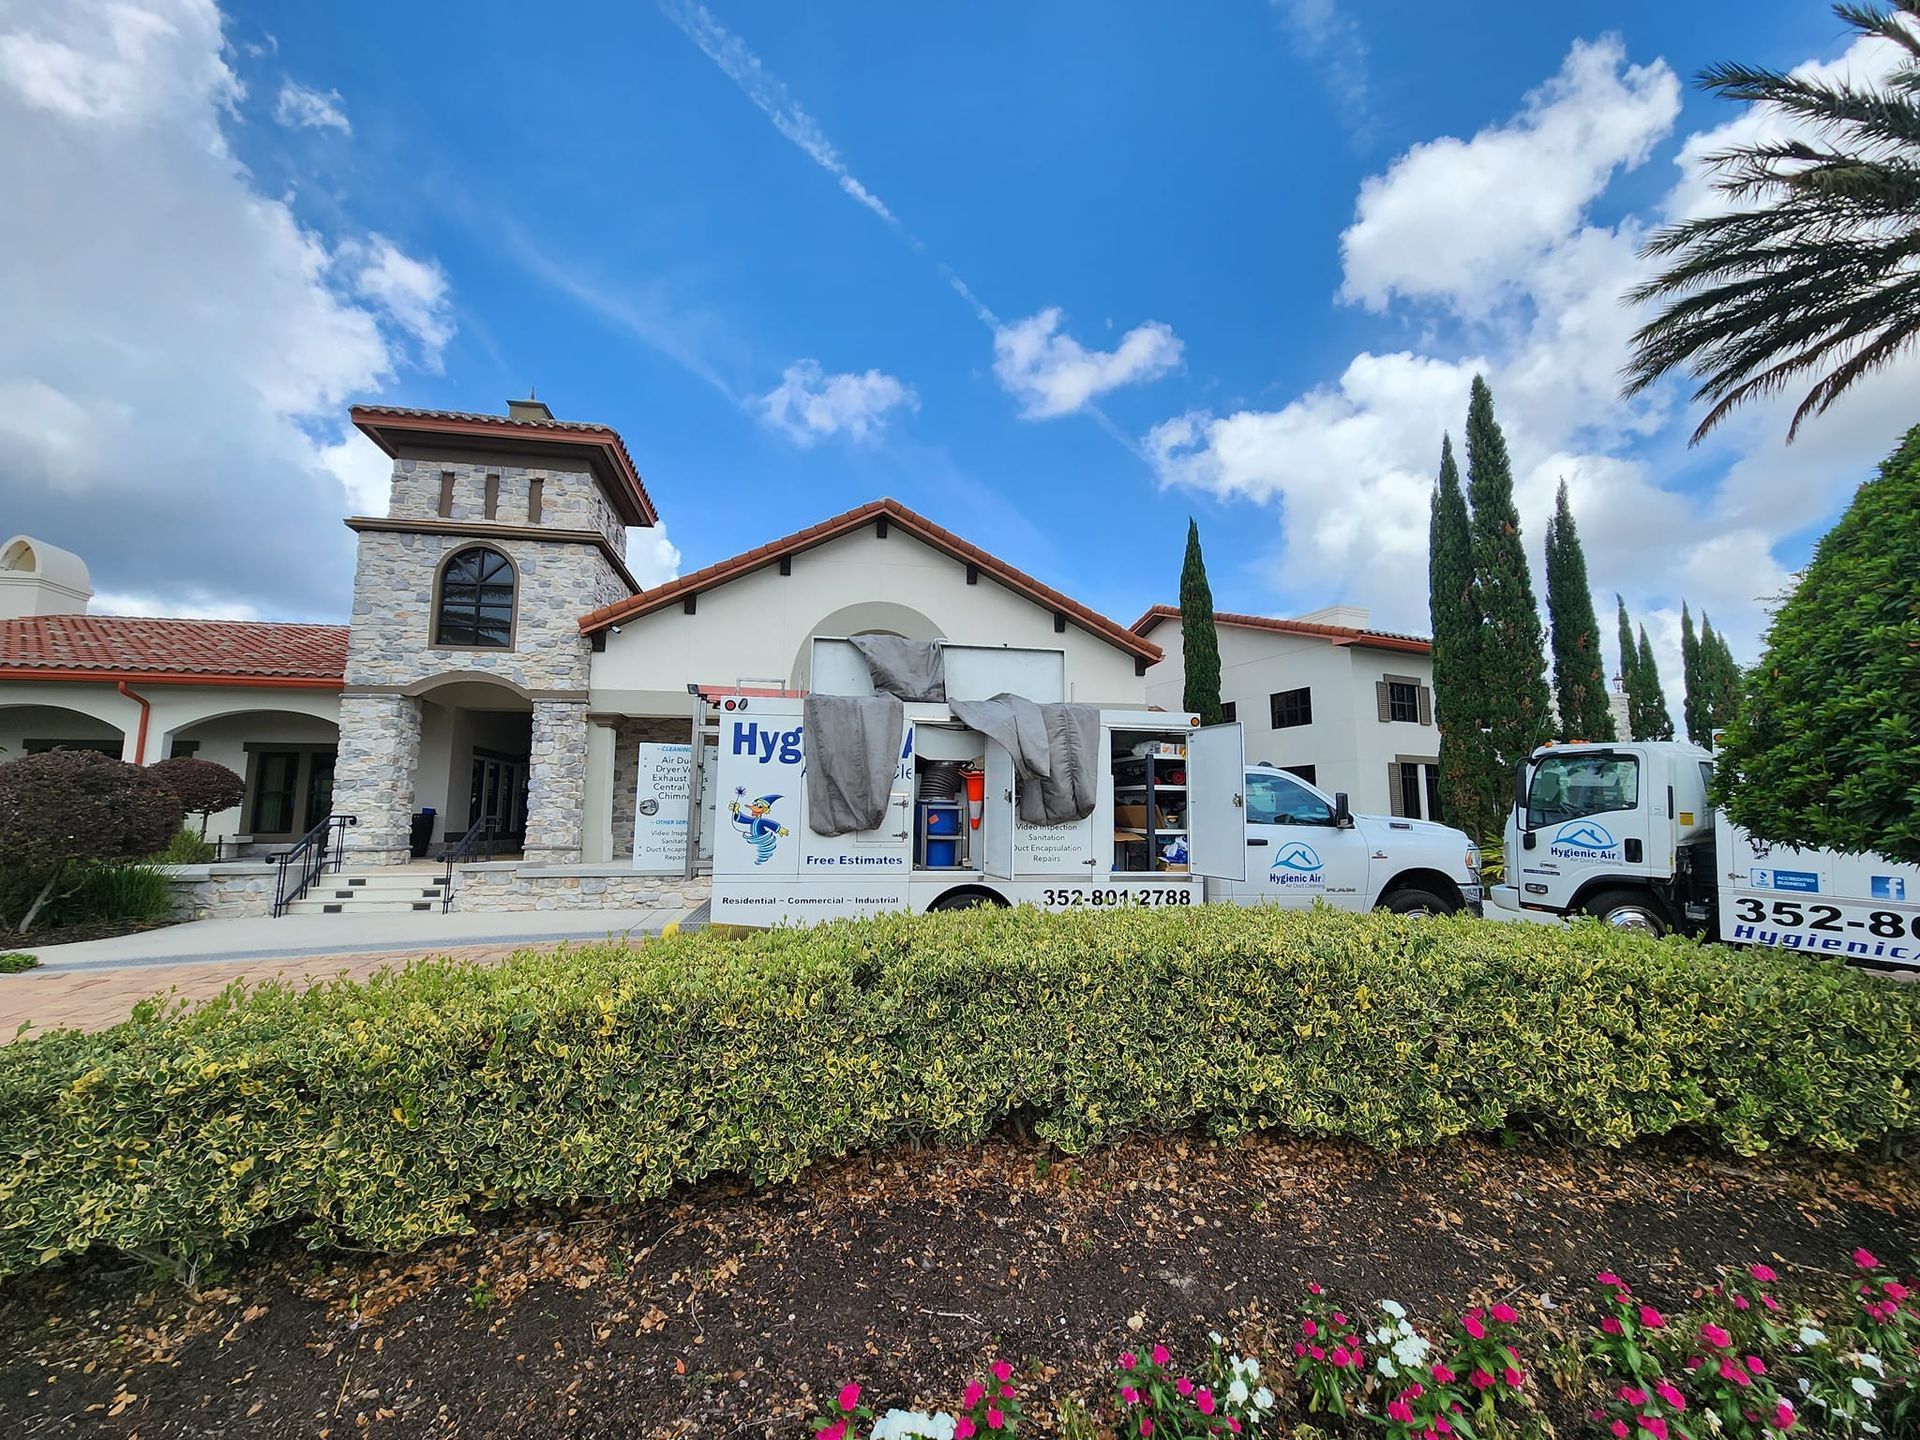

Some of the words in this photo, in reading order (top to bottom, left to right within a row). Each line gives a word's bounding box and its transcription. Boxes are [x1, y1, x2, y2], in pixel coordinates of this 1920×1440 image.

[661, 756, 674, 764] Air
[656, 765, 680, 774] Dryer
[652, 774, 687, 782] Exhaust
[653, 783, 685, 791] Central
[1016, 823, 1038, 831] Video
[1040, 823, 1078, 832] Inspection
[1028, 833, 1065, 841] Sanitation
[1030, 844, 1081, 853] Encapsulation
[1550, 847, 1597, 859] Hygienic
[1600, 850, 1617, 860] Air
[806, 855, 835, 866] Free
[839, 855, 903, 866] Estimates
[1033, 854, 1061, 863] Repairs
[1269, 873, 1307, 885] Hygienic
[1309, 873, 1322, 883] Air
[722, 896, 776, 905] Residential
[788, 896, 844, 905] Commercial
[855, 896, 899, 904] Industrial
[1043, 889, 1191, 906] 352-801-2788
[1735, 898, 1920, 942] 352-8
[1734, 924, 1909, 959] Hygienic
